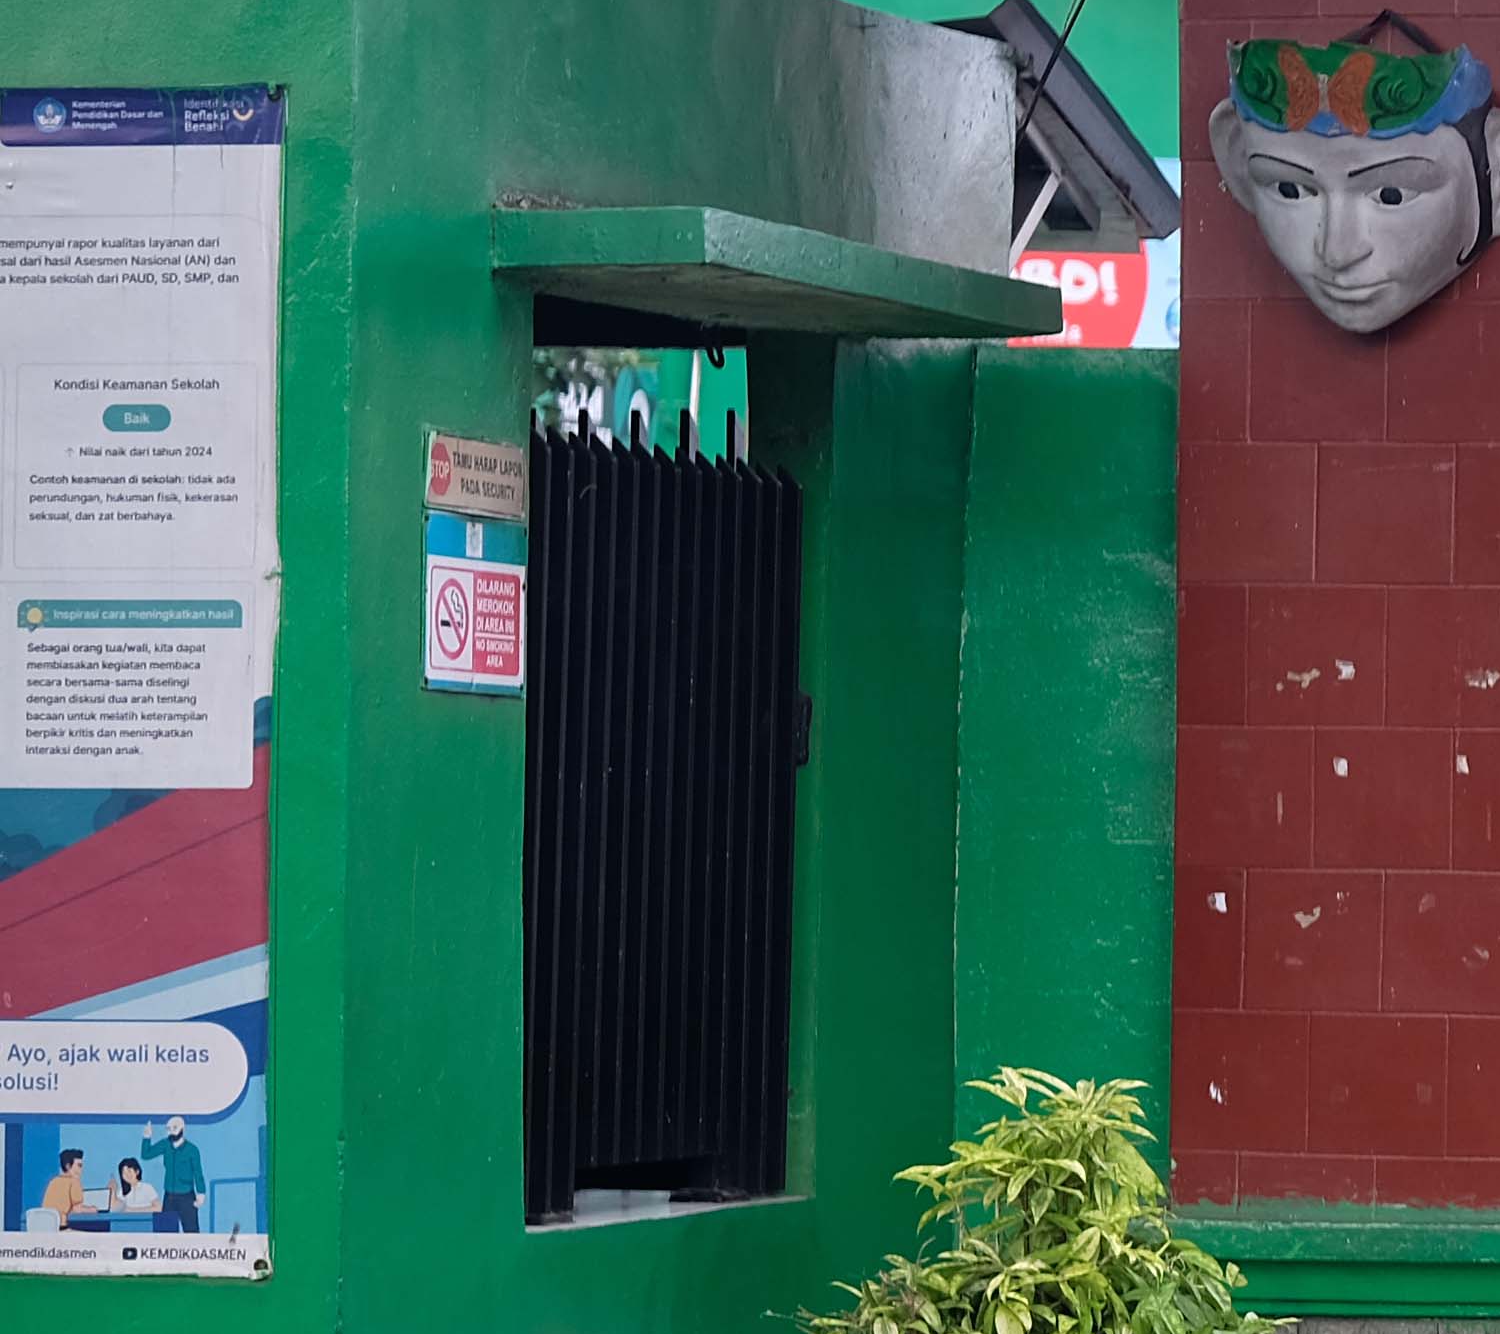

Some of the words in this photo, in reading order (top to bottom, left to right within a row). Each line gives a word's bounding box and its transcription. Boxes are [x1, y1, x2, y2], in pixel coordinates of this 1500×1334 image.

[72, 100, 126, 108] Kementerian
[72, 110, 119, 119] Pendidikan
[121, 110, 144, 119] Dasar
[147, 110, 163, 118] dan
[185, 109, 229, 121] Refleksi
[72, 121, 117, 131] Menengah
[68, 239, 97, 250] rapor
[101, 237, 145, 247] kualitas
[149, 237, 193, 250] layanan
[197, 237, 220, 247] dari
[20, 255, 41, 266] dari
[44, 254, 71, 265] hasil
[74, 256, 127, 266] Asesmen
[131, 255, 181, 266] Nasional
[184, 254, 210, 266] (AN)
[214, 255, 236, 265] dan
[9, 274, 46, 285] kepala
[50, 273, 93, 283] sekolah
[97, 273, 118, 283] dari
[122, 272, 157, 285] PAUD,
[161, 272, 181, 285] SD,
[184, 272, 214, 285] SMP,
[217, 273, 239, 283] dan
[54, 378, 99, 390] Kondisi
[103, 378, 167, 390] Keamanan
[172, 378, 220, 390] Sekolah
[124, 413, 150, 424] Baik
[79, 446, 102, 456] Nilai
[105, 447, 126, 456] naik
[129, 446, 150, 456] dari
[152, 446, 182, 456] tahun
[185, 446, 213, 456] 2024
[431, 460, 450, 479] STOP
[452, 451, 473, 469] TAMU
[474, 455, 498, 474] HARAP
[500, 458, 522, 478] LAPOR
[30, 474, 69, 484] Contoh
[71, 474, 126, 484] keamanan
[128, 474, 138, 484] di
[141, 474, 184, 484] sekolah:
[188, 474, 213, 484] tidak
[216, 475, 236, 484] ada
[461, 477, 480, 496] PADA
[482, 479, 515, 501] SECURITY
[29, 493, 103, 504] perundungan,
[106, 493, 154, 503] hukuman
[157, 492, 181, 503] fisik,
[184, 493, 239, 503] kekerasan
[29, 511, 72, 522] seksual,
[75, 512, 95, 521] dan
[98, 512, 114, 521] zat
[117, 511, 175, 523] berbahaya.
[476, 578, 515, 597] DILARANG
[476, 597, 515, 615] MEROKOK
[53, 609, 99, 621] Inspirasi
[102, 611, 124, 620] cara
[128, 609, 206, 621] meningkatkan
[208, 609, 234, 620] hasil
[476, 615, 484, 631] DI
[484, 616, 505, 633] AREA
[505, 618, 515, 634] INI
[27, 642, 70, 654] Sebagai
[72, 644, 103, 654] orang
[105, 642, 151, 654] tua/wali,
[154, 643, 173, 652] kita
[176, 643, 206, 654] dapat
[475, 638, 486, 652] NO
[486, 638, 514, 654] SMOKING
[26, 660, 100, 670] membiasakan
[102, 660, 147, 671] kegiatan
[149, 660, 201, 670] membaca
[486, 654, 503, 668] AREA
[26, 679, 62, 687] secara
[65, 678, 143, 687] bersama-sama
[146, 678, 190, 689] diselingi
[26, 694, 66, 706] dengan
[68, 694, 105, 704] diskusi
[108, 694, 128, 704] dua
[131, 694, 154, 704] arah
[157, 695, 197, 706] tentang
[26, 745, 71, 755] interaksi
[72, 745, 112, 757] dengan
[115, 746, 144, 755] anak.
[8, 1044, 52, 1066] Ayo,
[58, 1043, 100, 1066] ajak
[107, 1044, 149, 1063] wali
[155, 1044, 209, 1063] kelas
[140, 1247, 247, 1260] KEMDIKDASMEN
